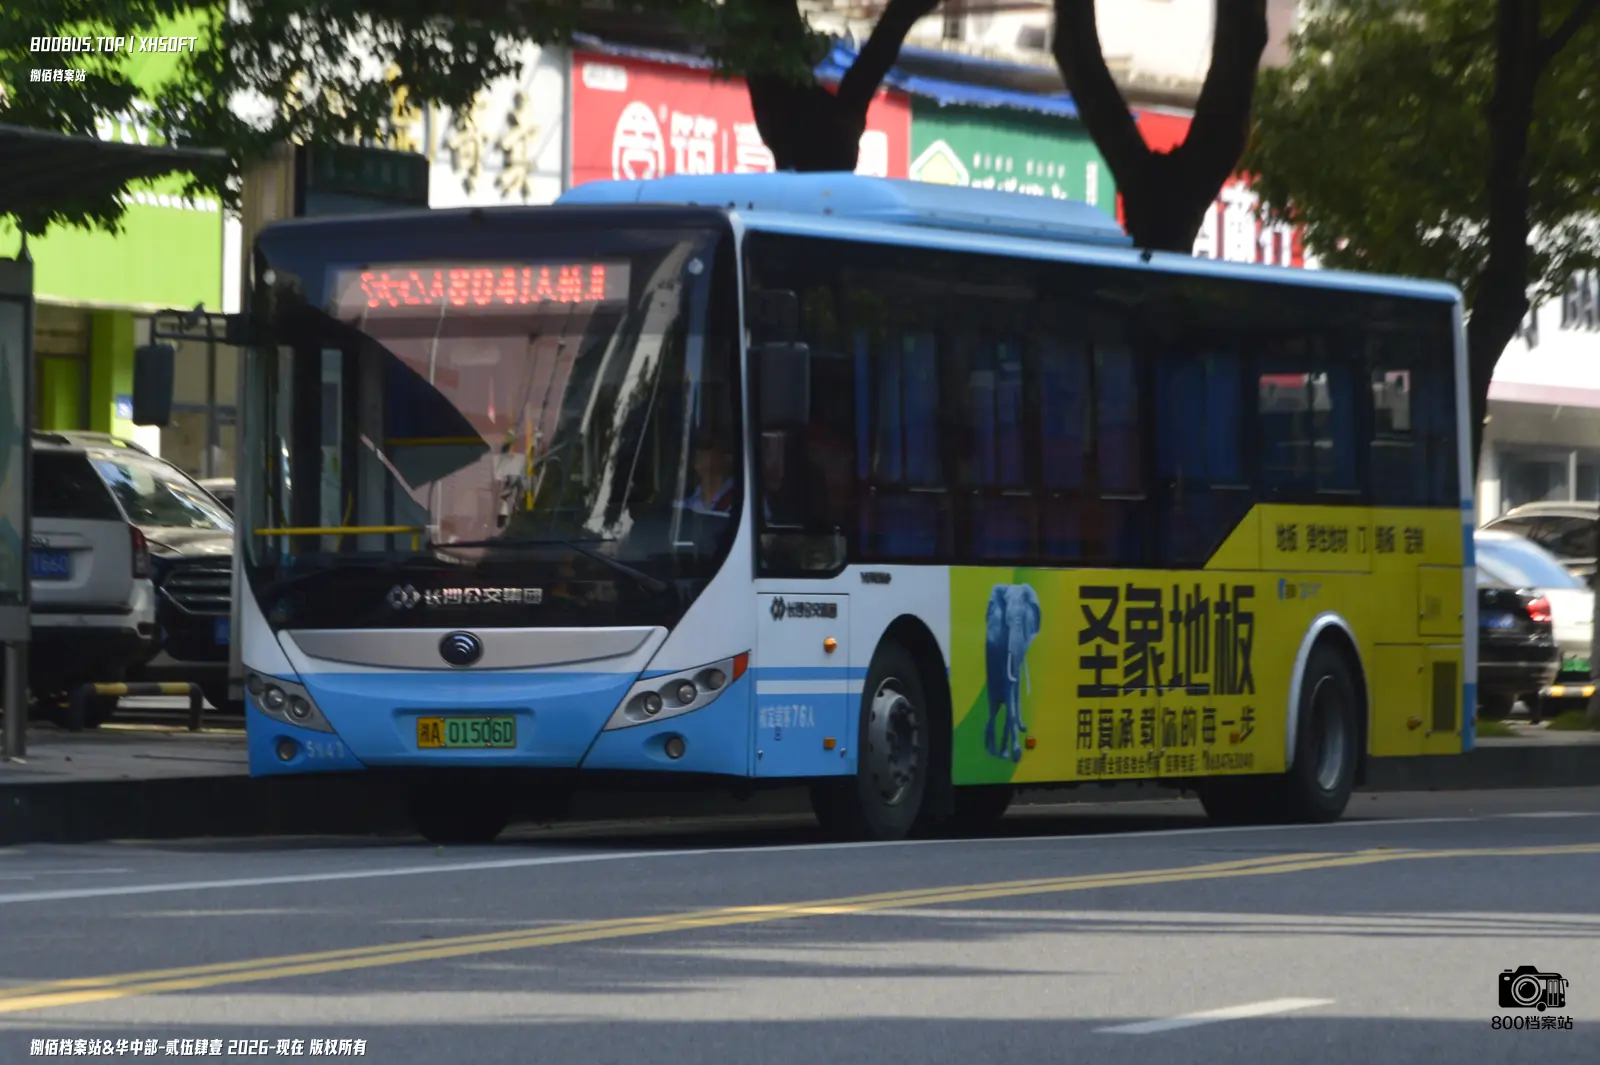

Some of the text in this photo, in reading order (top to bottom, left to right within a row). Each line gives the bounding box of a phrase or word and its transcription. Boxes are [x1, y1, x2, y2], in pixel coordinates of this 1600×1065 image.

[424, 587, 543, 605] 长沙公交集团
[1076, 582, 1256, 699] 圣象地板
